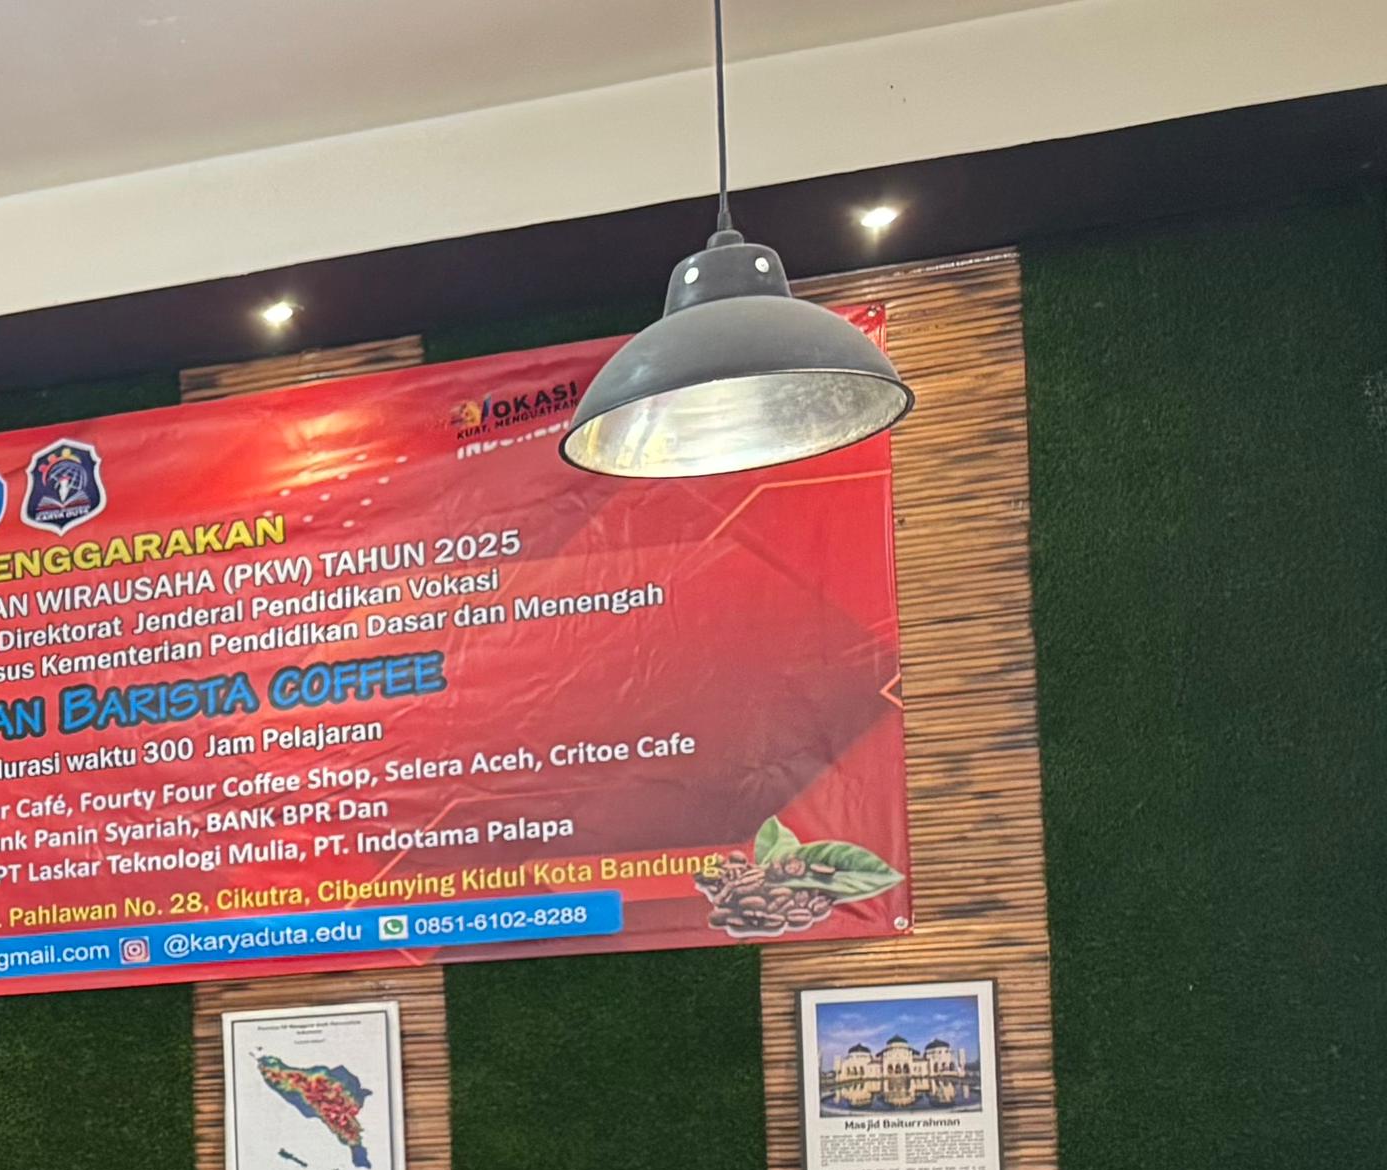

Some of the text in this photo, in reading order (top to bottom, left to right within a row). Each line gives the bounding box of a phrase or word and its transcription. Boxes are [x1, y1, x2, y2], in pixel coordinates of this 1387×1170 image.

[35, 569, 216, 614] WIRAUSAHA
[223, 555, 313, 595] (PKW)
[318, 541, 425, 578] TAHUN
[434, 529, 521, 564] 2025
[133, 599, 243, 634] Jenderal
[251, 577, 405, 620] Pendidikan
[408, 568, 498, 599] Vokasi
[41, 640, 202, 677] Kementerian
[210, 622, 359, 656] Pendidikan
[367, 611, 448, 637] Dasar
[453, 604, 506, 627] dan
[514, 582, 663, 620] Menengah
[16, 793, 73, 818] Café,
[80, 788, 156, 813] Fourty
[162, 783, 217, 804] Four
[222, 771, 301, 798] Coffee
[307, 765, 379, 790] Shop,
[384, 757, 463, 782] Selera
[470, 746, 543, 774] Aceh,
[549, 741, 630, 766] Critoe
[636, 732, 696, 758] Cafe
[66, 746, 137, 772] waktu
[143, 737, 194, 764] 300
[205, 734, 255, 758] Jam
[262, 722, 382, 751] Pelajaran
[28, 858, 102, 882] Laskar
[105, 844, 222, 874] Teknologi
[228, 839, 307, 865] Mulia,
[314, 834, 349, 857] PT.
[357, 827, 479, 854] Indotama
[487, 817, 574, 843] Palapa
[34, 824, 98, 849] Panin
[105, 814, 200, 846] Syariah,
[206, 806, 276, 833] BANK
[282, 801, 332, 826] BPR
[338, 799, 389, 821] Dan
[9, 903, 118, 928] Pahlawan
[124, 897, 163, 918] No.
[169, 891, 210, 915] 28,
[216, 886, 311, 911] Cikutra,
[317, 872, 456, 908] Cibeunying
[461, 863, 527, 892] Kidul
[533, 861, 594, 886] Kota
[600, 854, 721, 879] Bandung
[163, 922, 363, 958] @karyaduta.edu
[414, 906, 588, 936] 0851-6102-8288
[844, 1117, 961, 1132] Masjid Baiturrahman
